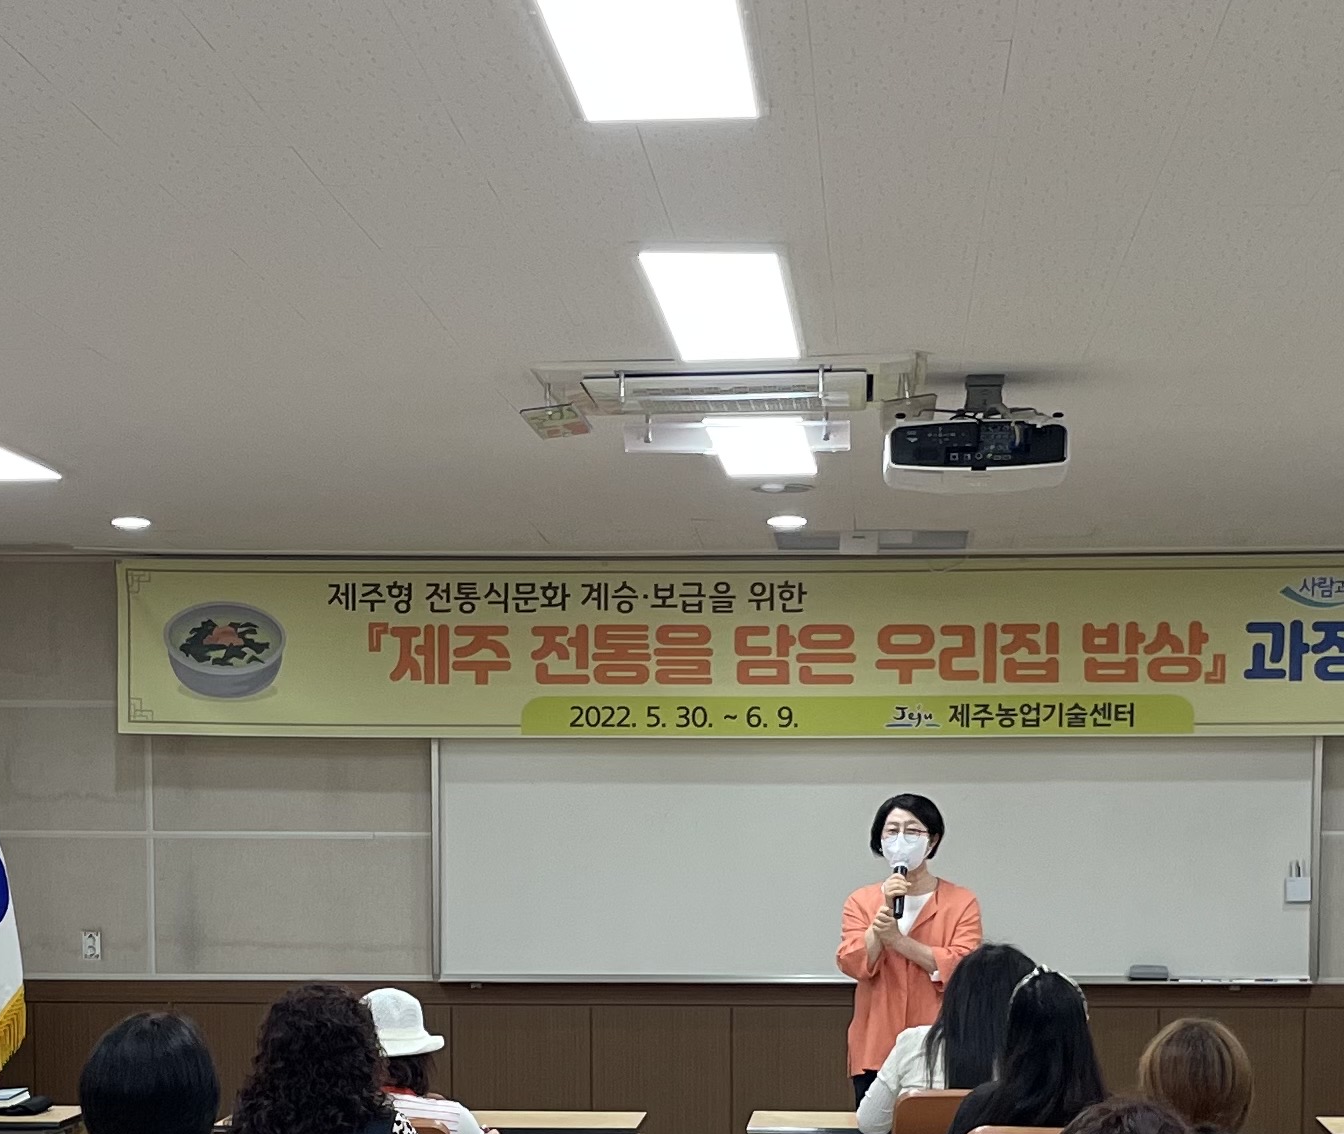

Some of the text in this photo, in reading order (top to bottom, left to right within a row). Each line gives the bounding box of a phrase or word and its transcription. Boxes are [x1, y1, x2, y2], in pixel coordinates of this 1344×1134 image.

[327, 580, 808, 614] 제주형 전통식문화 계승·보급을 위한
[530, 623, 714, 686] 전통을
[734, 623, 856, 686] 담은
[874, 621, 1060, 686] 우리집
[569, 705, 637, 728] 2022.
[646, 705, 667, 728] 5.
[675, 705, 713, 728] 30.
[745, 705, 768, 728] 6.
[776, 705, 799, 728] 9.
[892, 703, 934, 729] Jeju
[948, 702, 1135, 728] 제주농업기술센터
